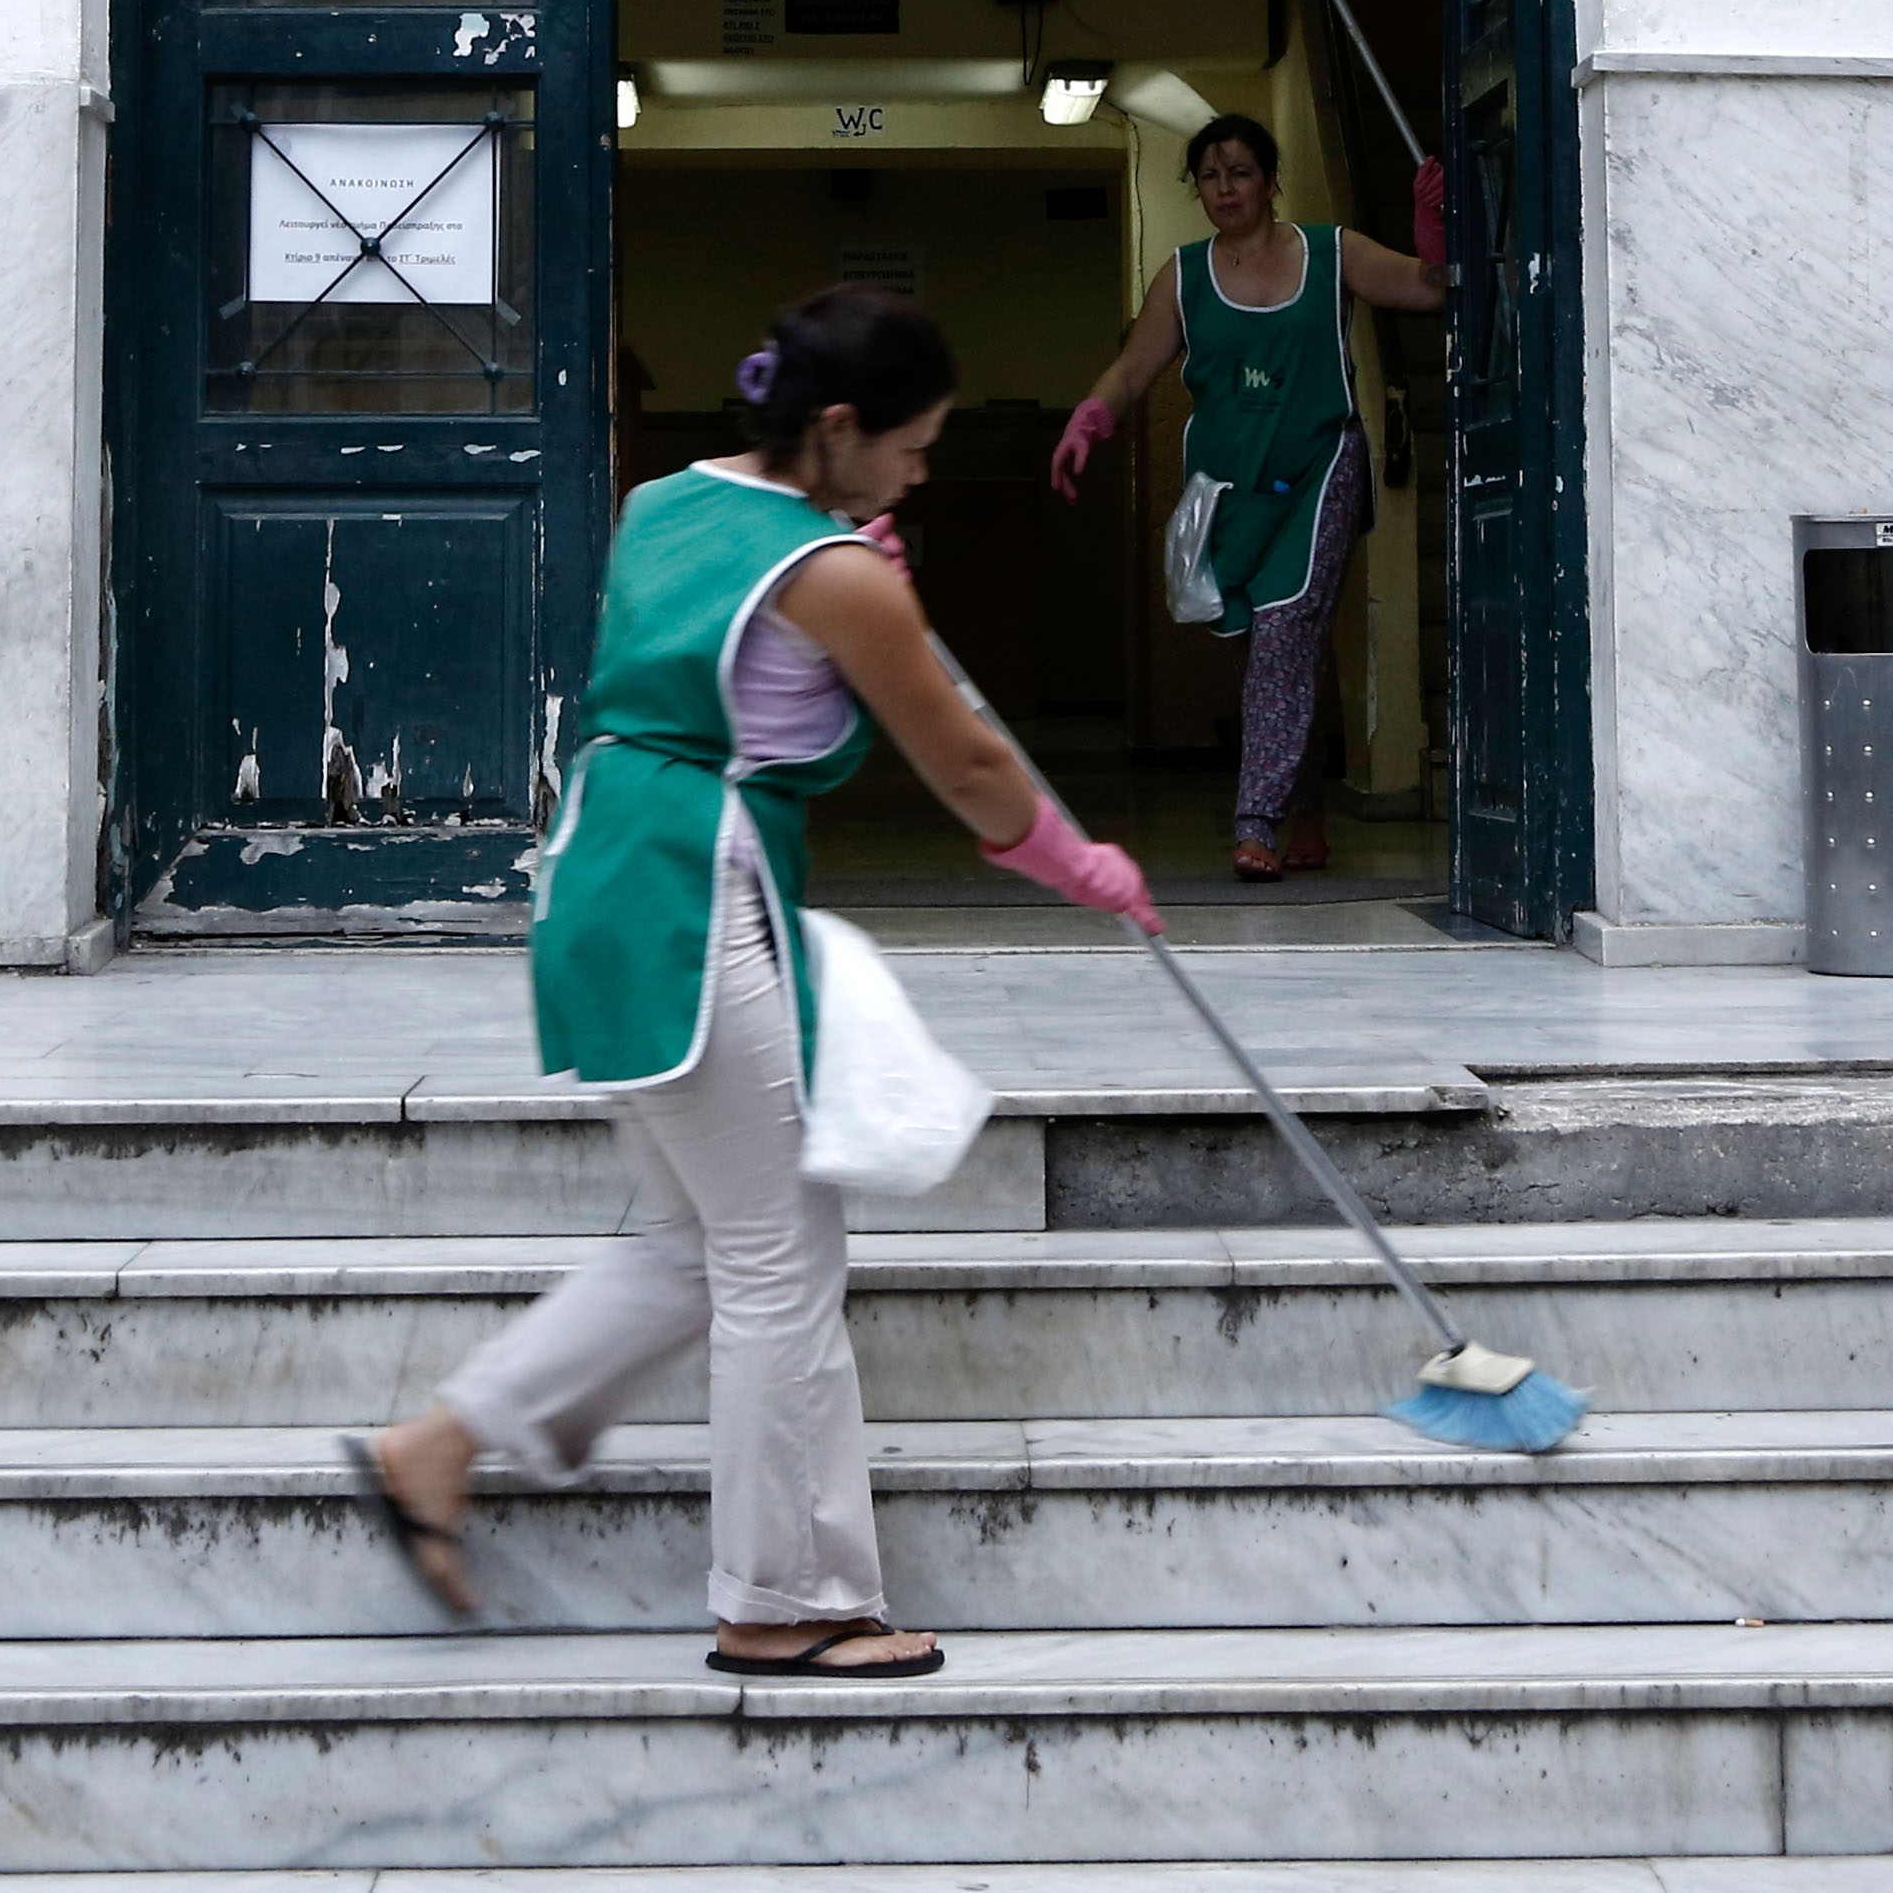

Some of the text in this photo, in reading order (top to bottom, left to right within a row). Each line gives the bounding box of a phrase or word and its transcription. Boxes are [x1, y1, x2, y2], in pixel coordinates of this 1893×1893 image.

[330, 178, 414, 188] ΑΝΑΚΟΙΝΩΣΗ
[279, 220, 328, 229] Λειτουργεί
[349, 220, 377, 230] μήμα
[379, 221, 444, 231] Πείσπραξης
[284, 252, 313, 262] Κτίριο
[415, 254, 456, 264] Τριμελές
